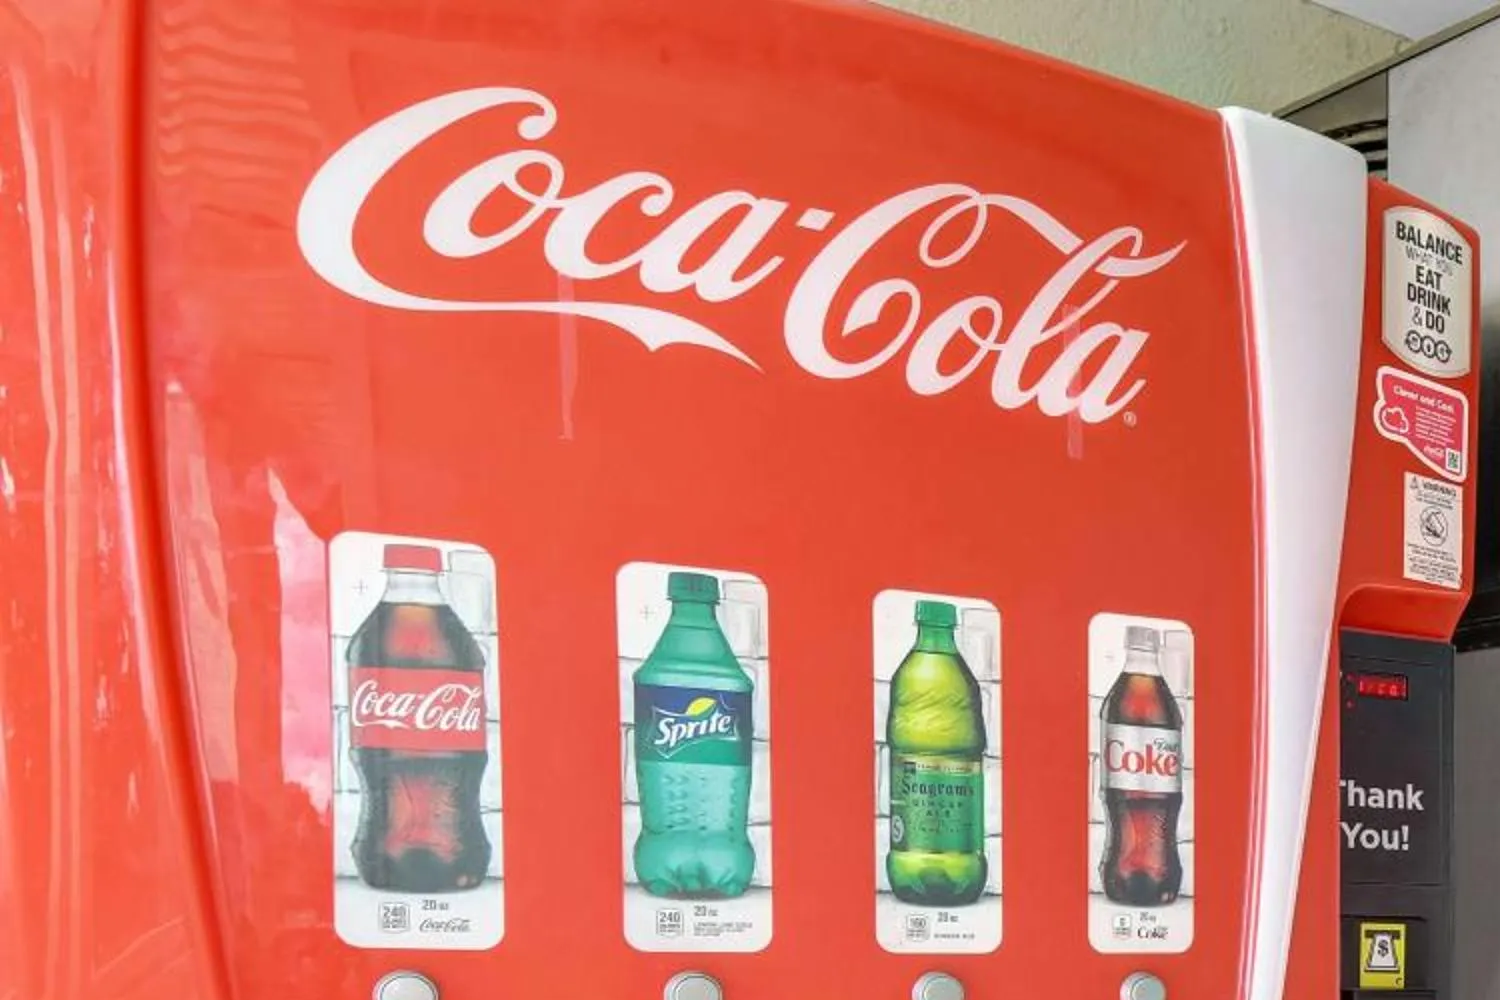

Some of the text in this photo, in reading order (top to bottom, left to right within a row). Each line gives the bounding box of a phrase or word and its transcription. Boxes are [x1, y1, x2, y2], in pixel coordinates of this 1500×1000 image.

[297, 87, 1186, 424] Coca-Cola
[1396, 221, 1462, 264] BALANCE
[1416, 265, 1442, 291] EAT
[1408, 283, 1451, 316] DRINK
[1412, 307, 1444, 334] & DO
[351, 679, 482, 732] Coca-Cola
[654, 713, 731, 748] Sprite
[1104, 740, 1177, 776] Coke
[1339, 821, 1409, 850] You!
[659, 912, 681, 923] 240
